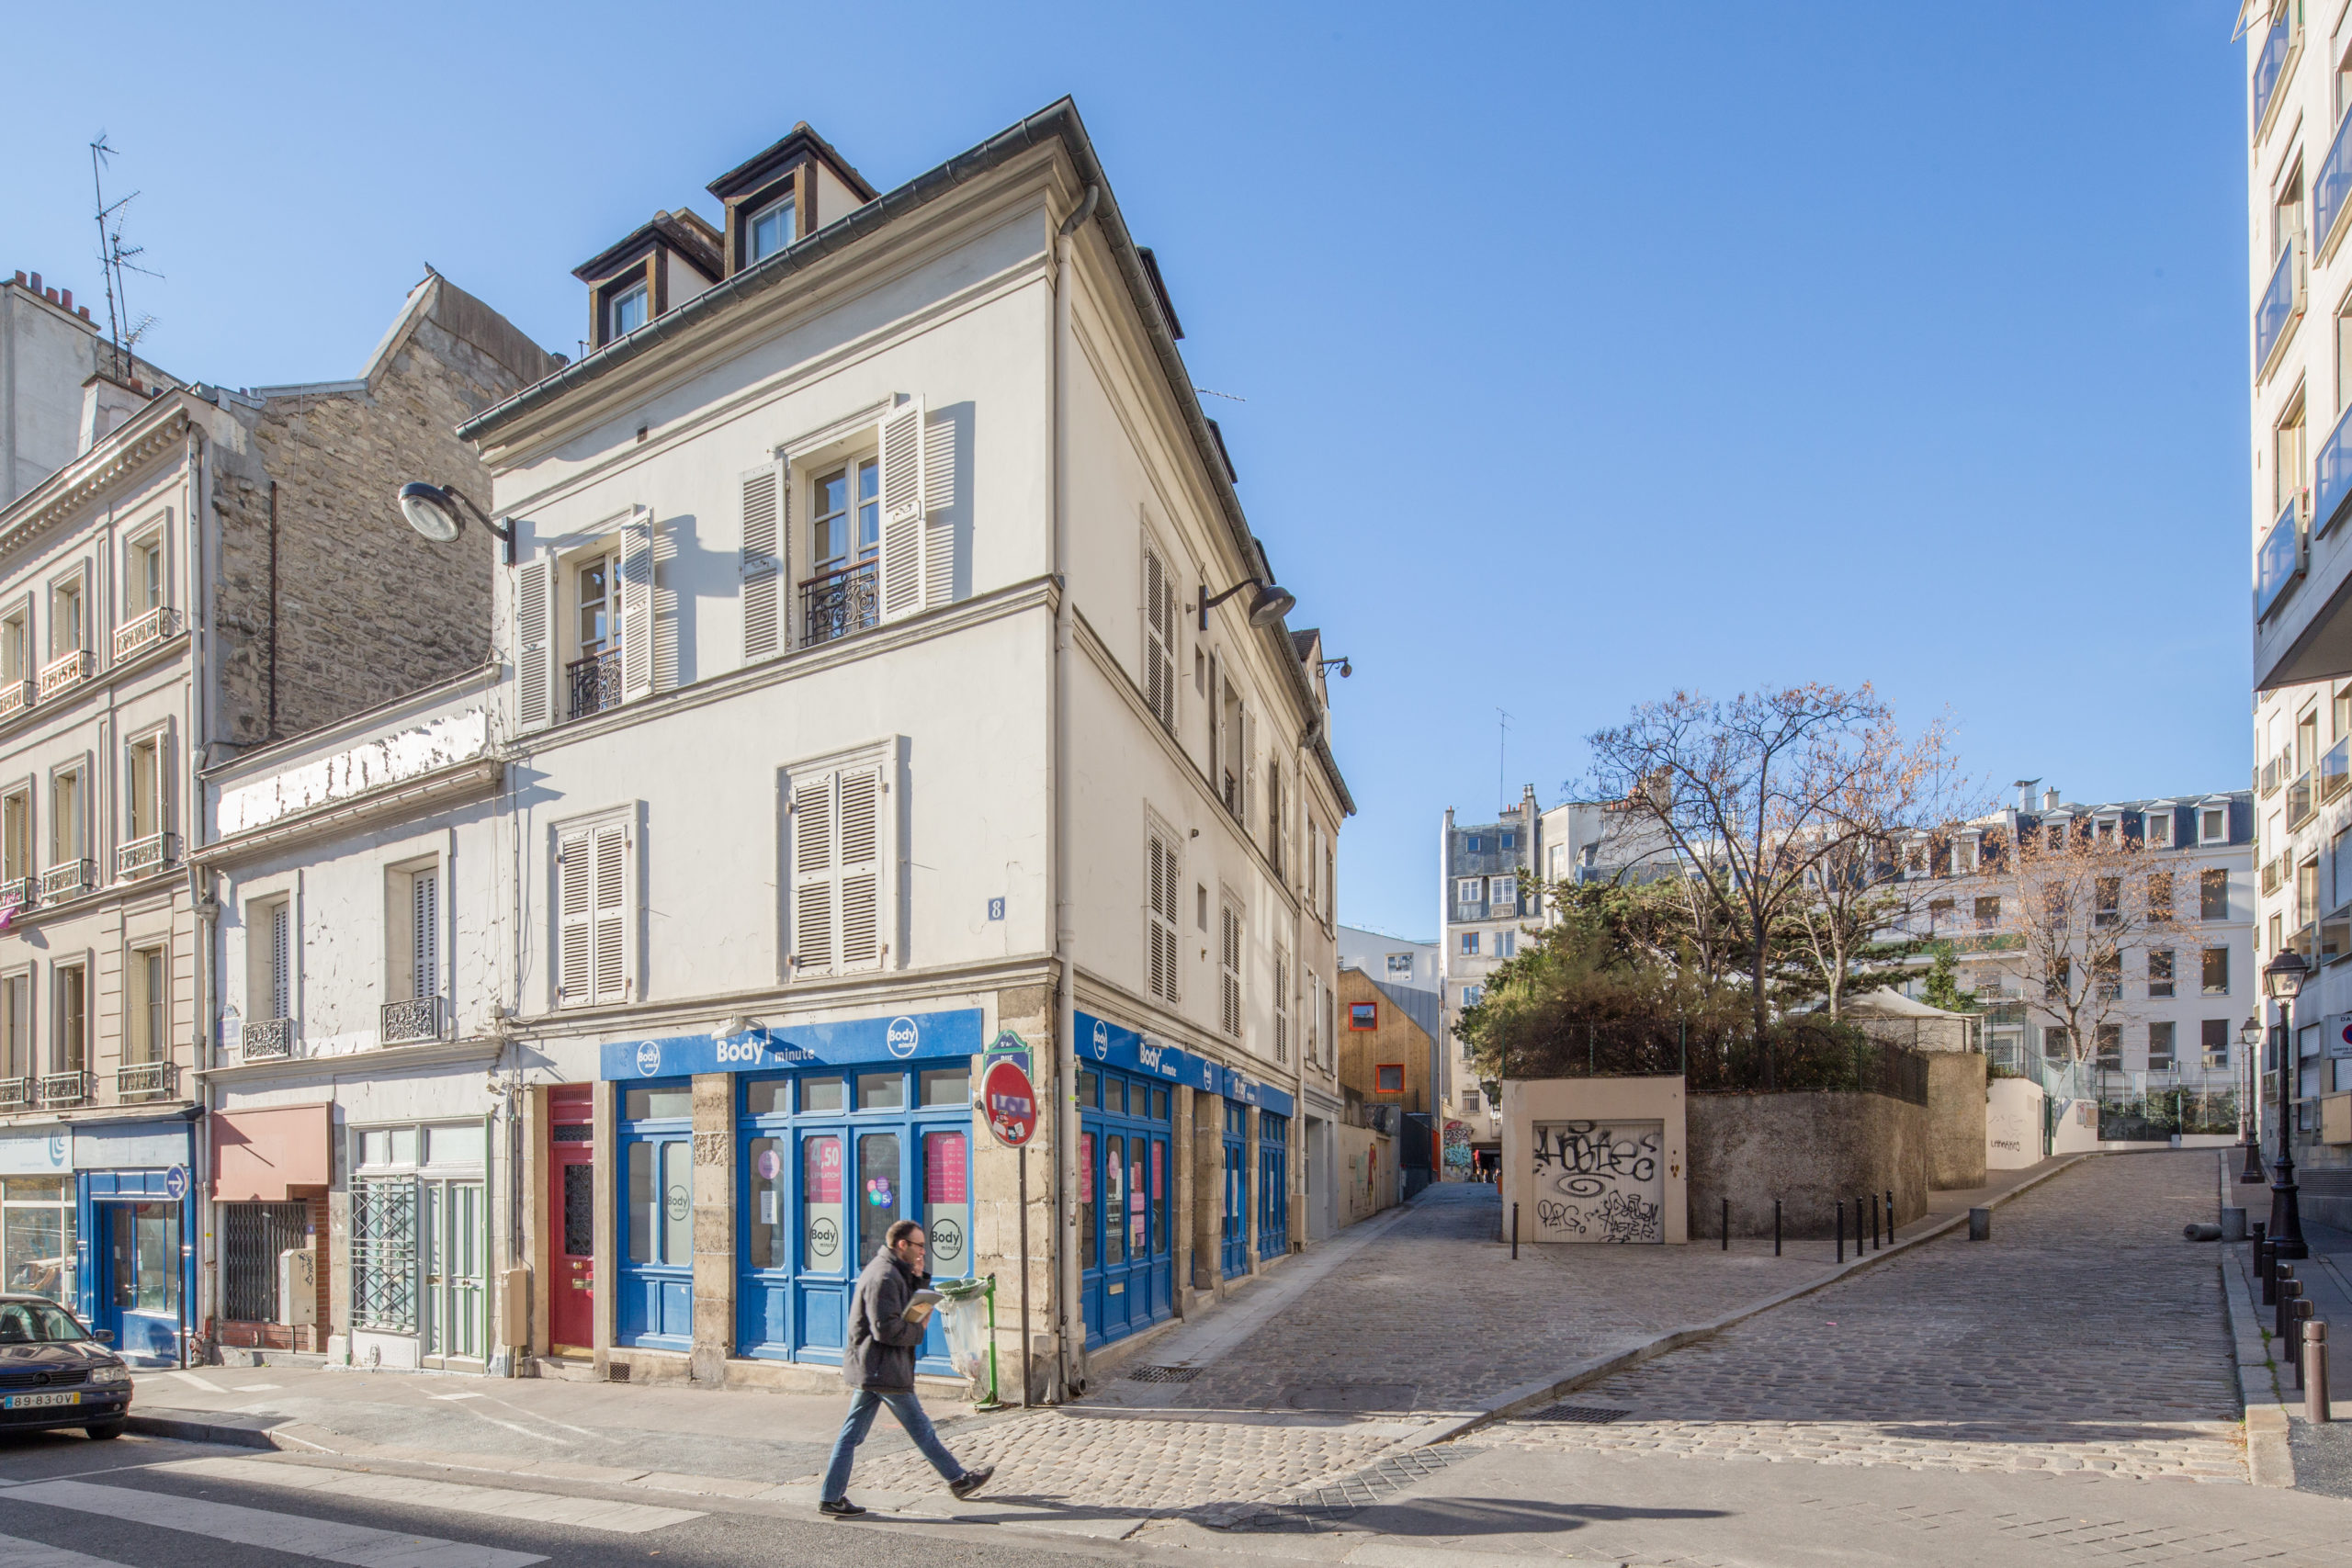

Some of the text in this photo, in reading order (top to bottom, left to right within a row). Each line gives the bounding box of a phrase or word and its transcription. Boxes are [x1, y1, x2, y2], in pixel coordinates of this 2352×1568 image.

[992, 900, 1001, 919] 8
[775, 1048, 815, 1063] minute
[1161, 1064, 1177, 1077] minute
